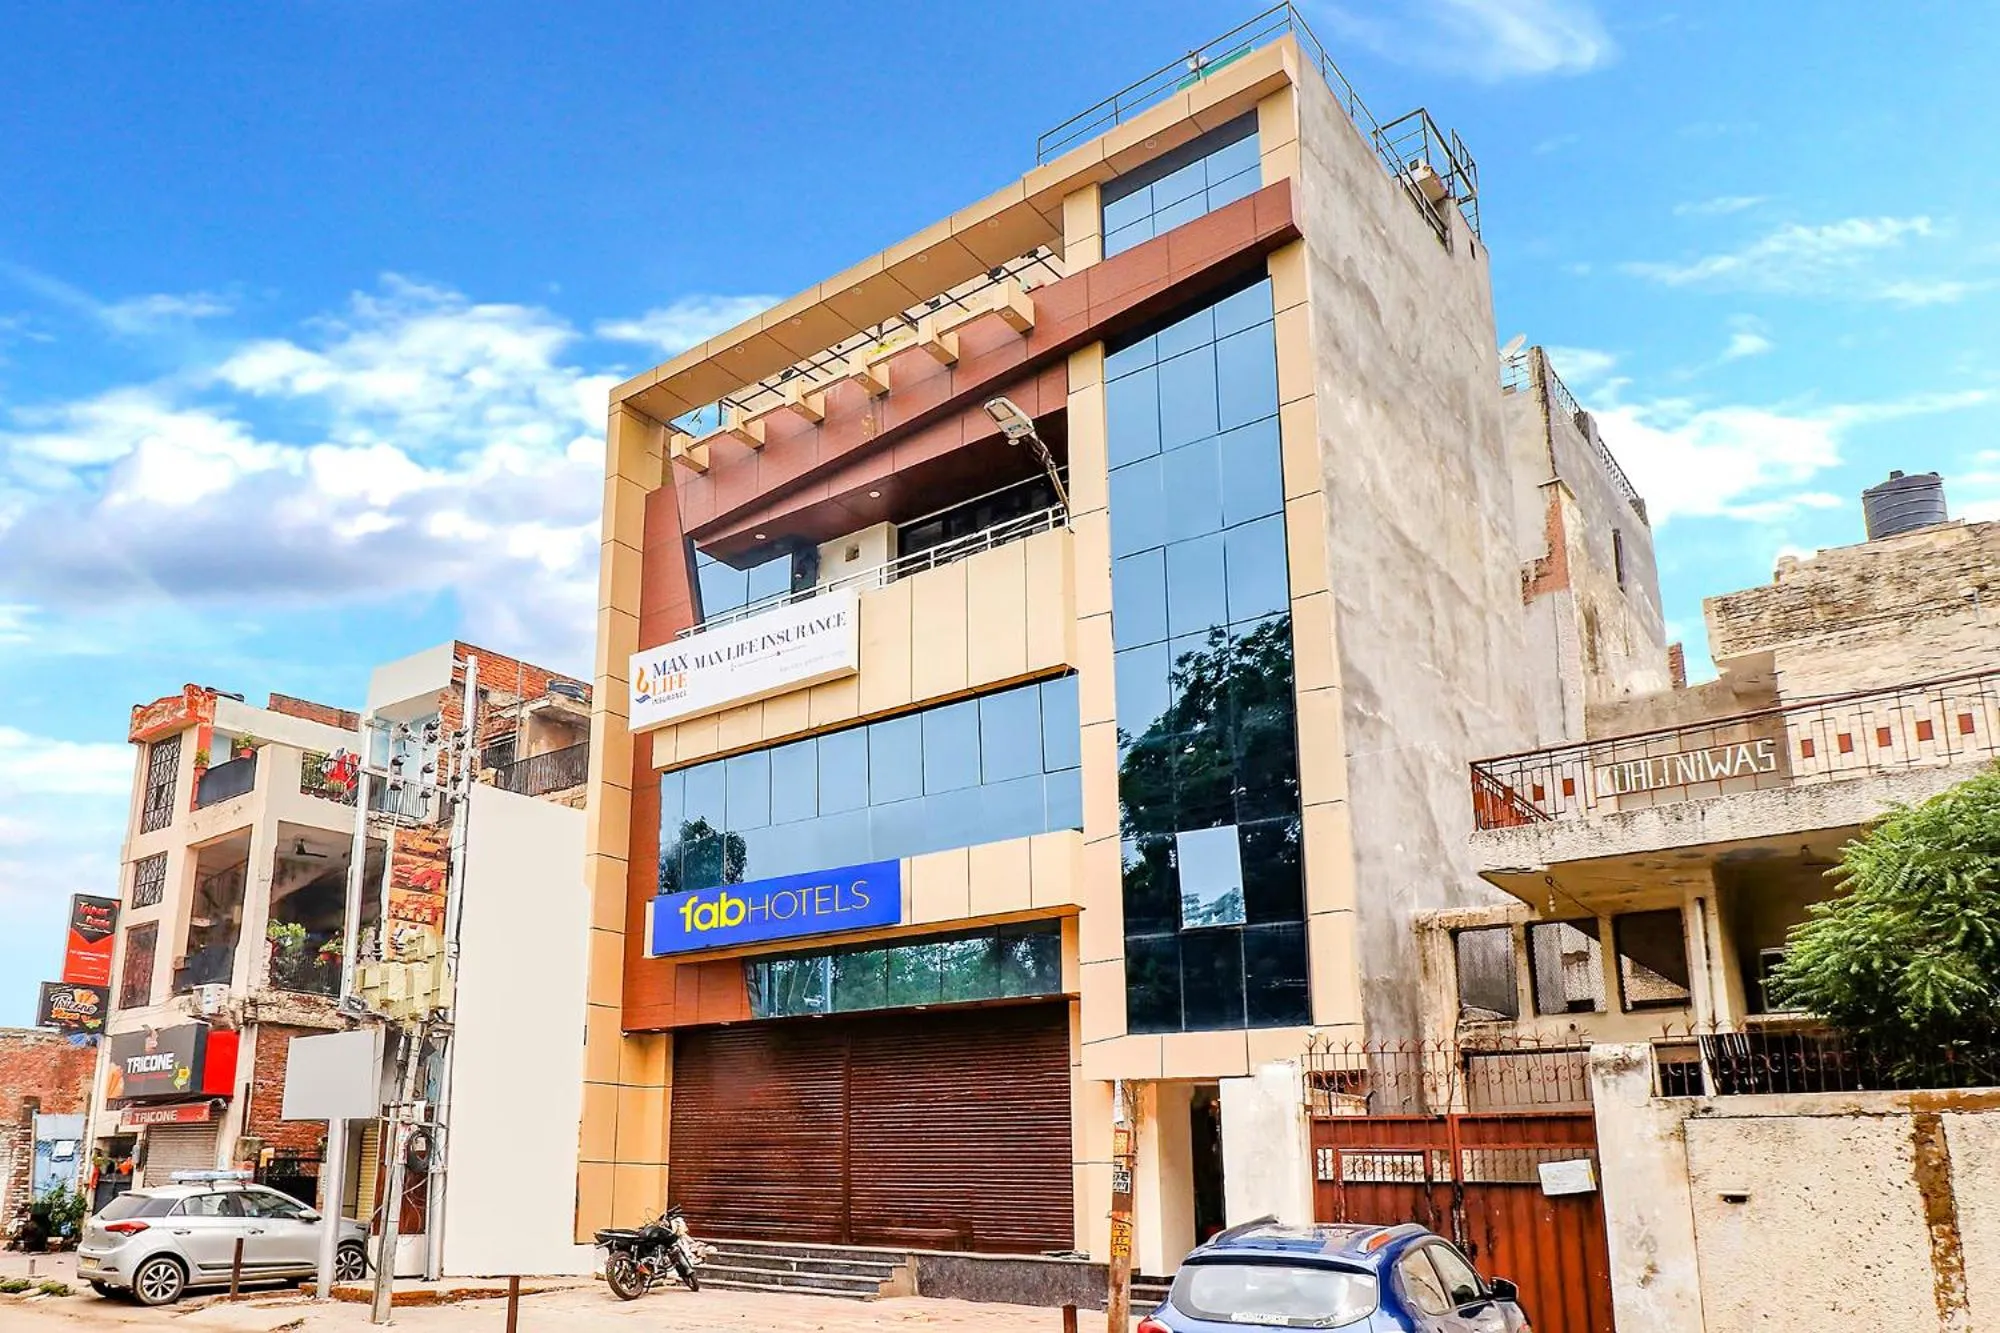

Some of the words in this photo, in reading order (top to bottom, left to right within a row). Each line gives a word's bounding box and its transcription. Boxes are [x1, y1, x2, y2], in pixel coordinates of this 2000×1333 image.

[694, 650, 724, 671] MAX
[727, 637, 759, 661] LIFE
[760, 611, 848, 651] INSURANCE
[653, 653, 690, 679] MAX
[651, 673, 687, 696] LIFE
[1676, 739, 1777, 785] NIWAS
[127, 1052, 175, 1074] TRICONE
[135, 1109, 178, 1123] TRICONE
